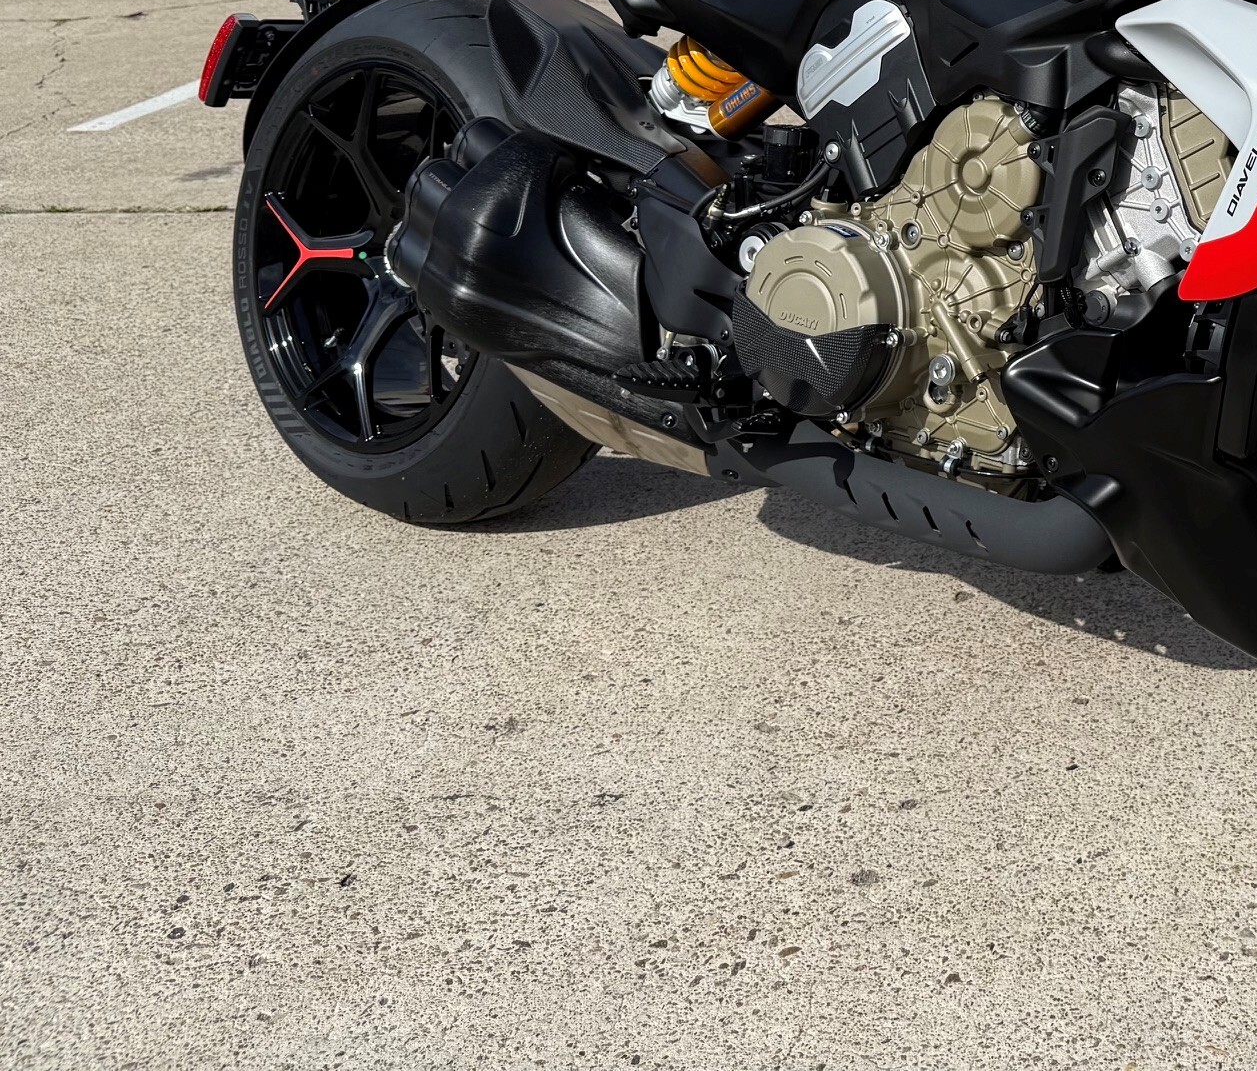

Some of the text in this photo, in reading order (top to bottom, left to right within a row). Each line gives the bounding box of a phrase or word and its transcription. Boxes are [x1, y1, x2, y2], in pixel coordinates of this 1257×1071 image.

[237, 216, 249, 290] ROSSO
[240, 297, 268, 379] DIABLO
[778, 310, 820, 331] DUCATI
